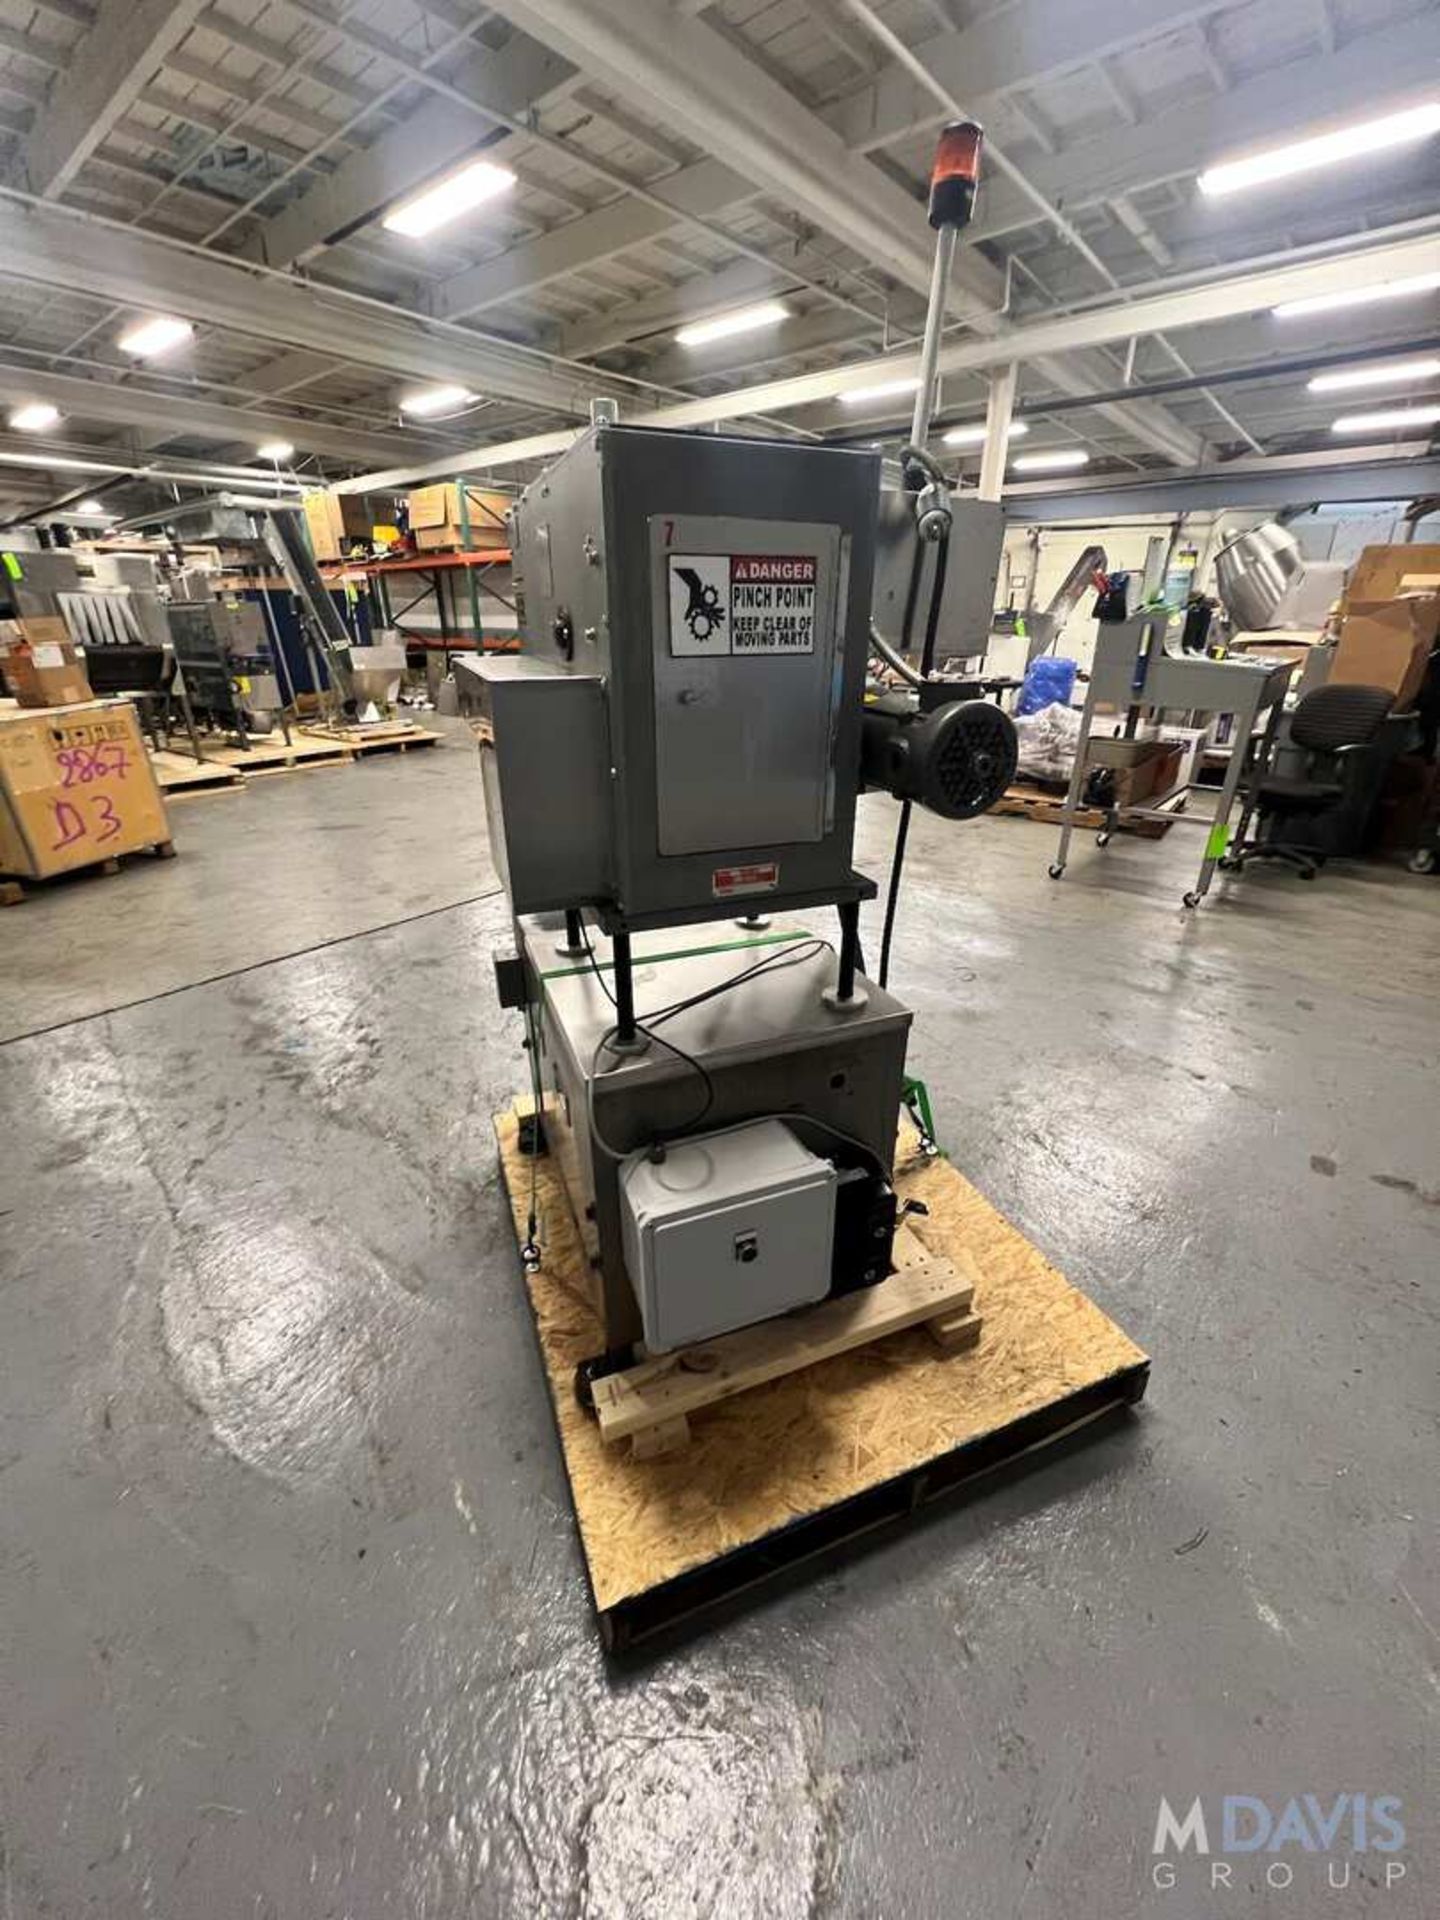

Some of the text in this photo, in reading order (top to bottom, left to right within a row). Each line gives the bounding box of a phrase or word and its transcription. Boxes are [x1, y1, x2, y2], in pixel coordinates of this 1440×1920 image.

[664, 521, 675, 547] 7
[750, 562, 814, 579] DANGER
[733, 586, 813, 609] PINCH POINT
[733, 616, 812, 632] KEEP CLEAR OF
[735, 631, 810, 647] MOVING PARTS
